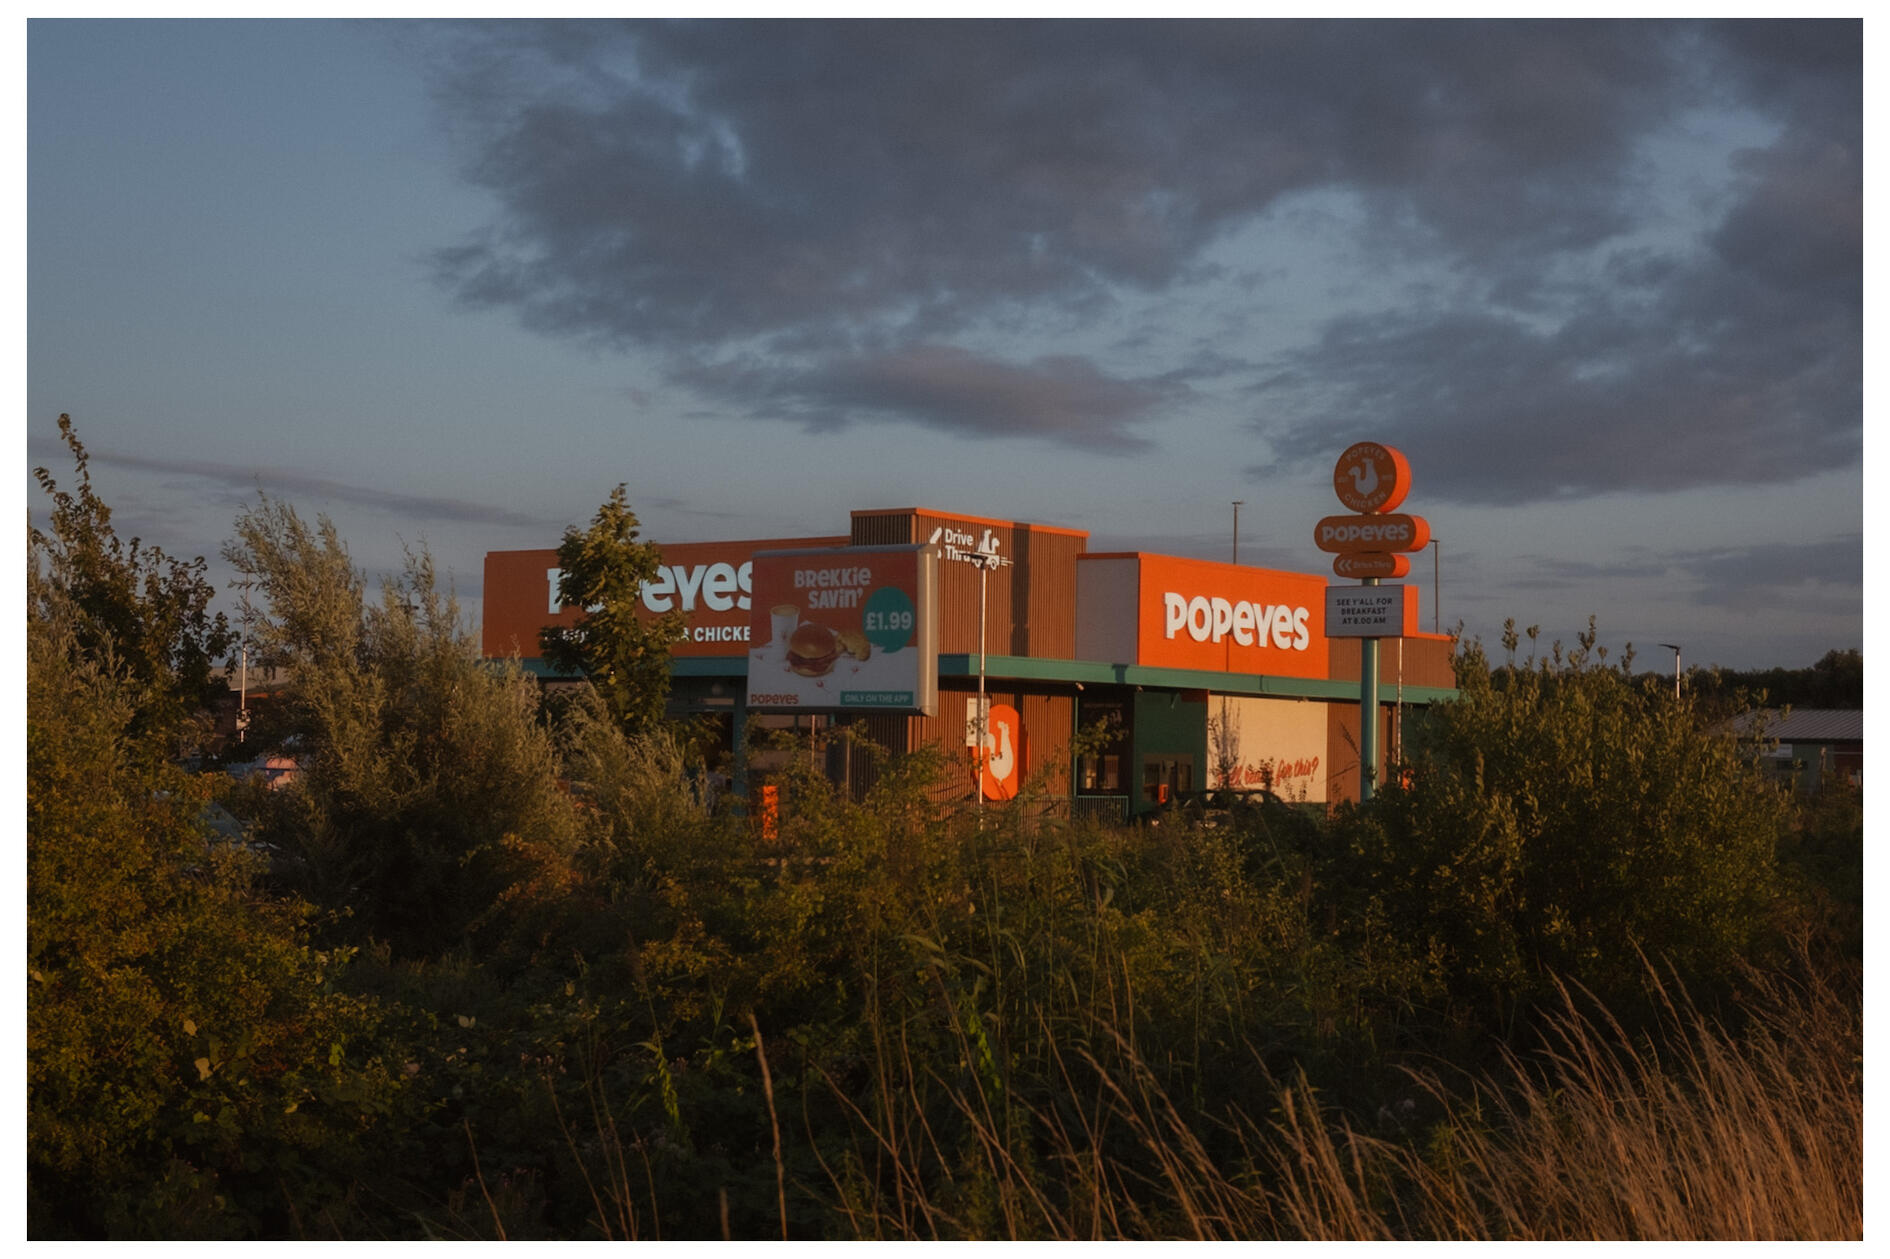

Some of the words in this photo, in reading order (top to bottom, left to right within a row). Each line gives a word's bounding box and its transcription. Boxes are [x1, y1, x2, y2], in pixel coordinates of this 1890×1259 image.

[1346, 446, 1385, 461] POPEYES
[945, 528, 974, 546] Drive
[1322, 523, 1409, 543] POPeYeS
[794, 567, 872, 588] BReKKie
[547, 561, 753, 615] PeYeS
[808, 588, 863, 609] SAVin'
[1336, 598, 1349, 606] SEE
[1376, 597, 1392, 606] FOR
[1341, 607, 1386, 616] BREAKFAST
[865, 611, 912, 631] £1.99
[1164, 592, 1310, 651] POPeYeS
[1342, 617, 1352, 625] AT
[1373, 617, 1386, 625] AM
[694, 626, 751, 642] CHICKE
[750, 693, 799, 705] POPeYeS
[845, 694, 864, 704] ONLY
[865, 694, 877, 703] ON
[879, 694, 893, 703] THE
[894, 694, 910, 703] APP
